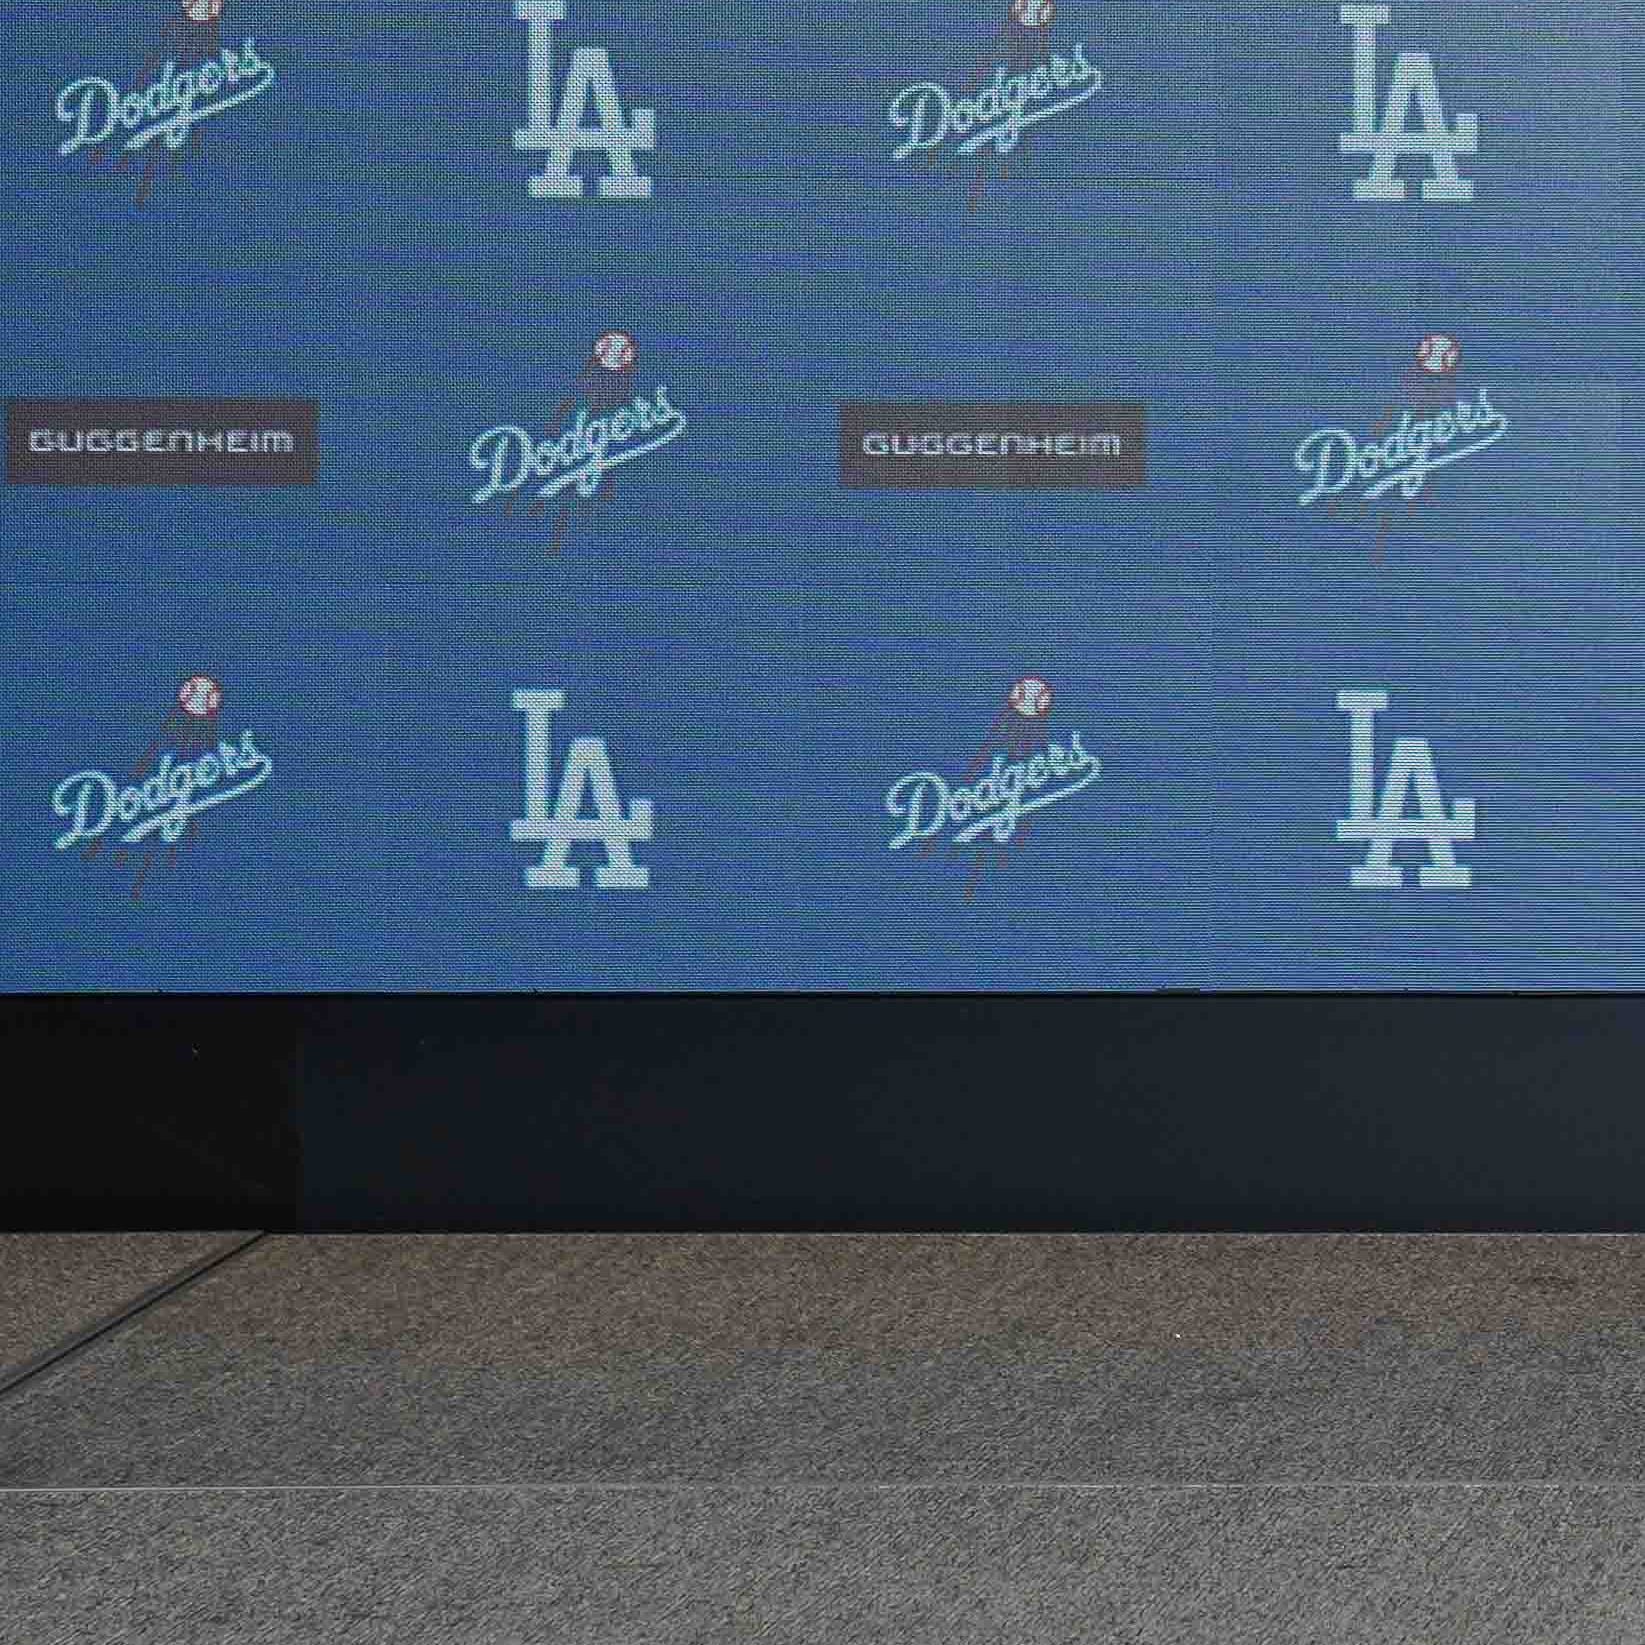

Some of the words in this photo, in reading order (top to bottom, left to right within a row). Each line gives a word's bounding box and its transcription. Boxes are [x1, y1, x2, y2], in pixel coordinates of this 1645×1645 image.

[54, 37, 274, 156] Dodgers
[888, 43, 1102, 160] Dodgers
[1339, 3, 1478, 202] LA
[27, 428, 295, 455] GUGGENHEIM
[468, 384, 687, 504] Dodgers
[861, 431, 1123, 458] GUGGENHEIM
[1294, 386, 1509, 505] Dodgers
[51, 728, 273, 851] Dodgers
[509, 688, 655, 890] LA
[885, 731, 1100, 850] Dodgers
[1336, 689, 1476, 889] LA
